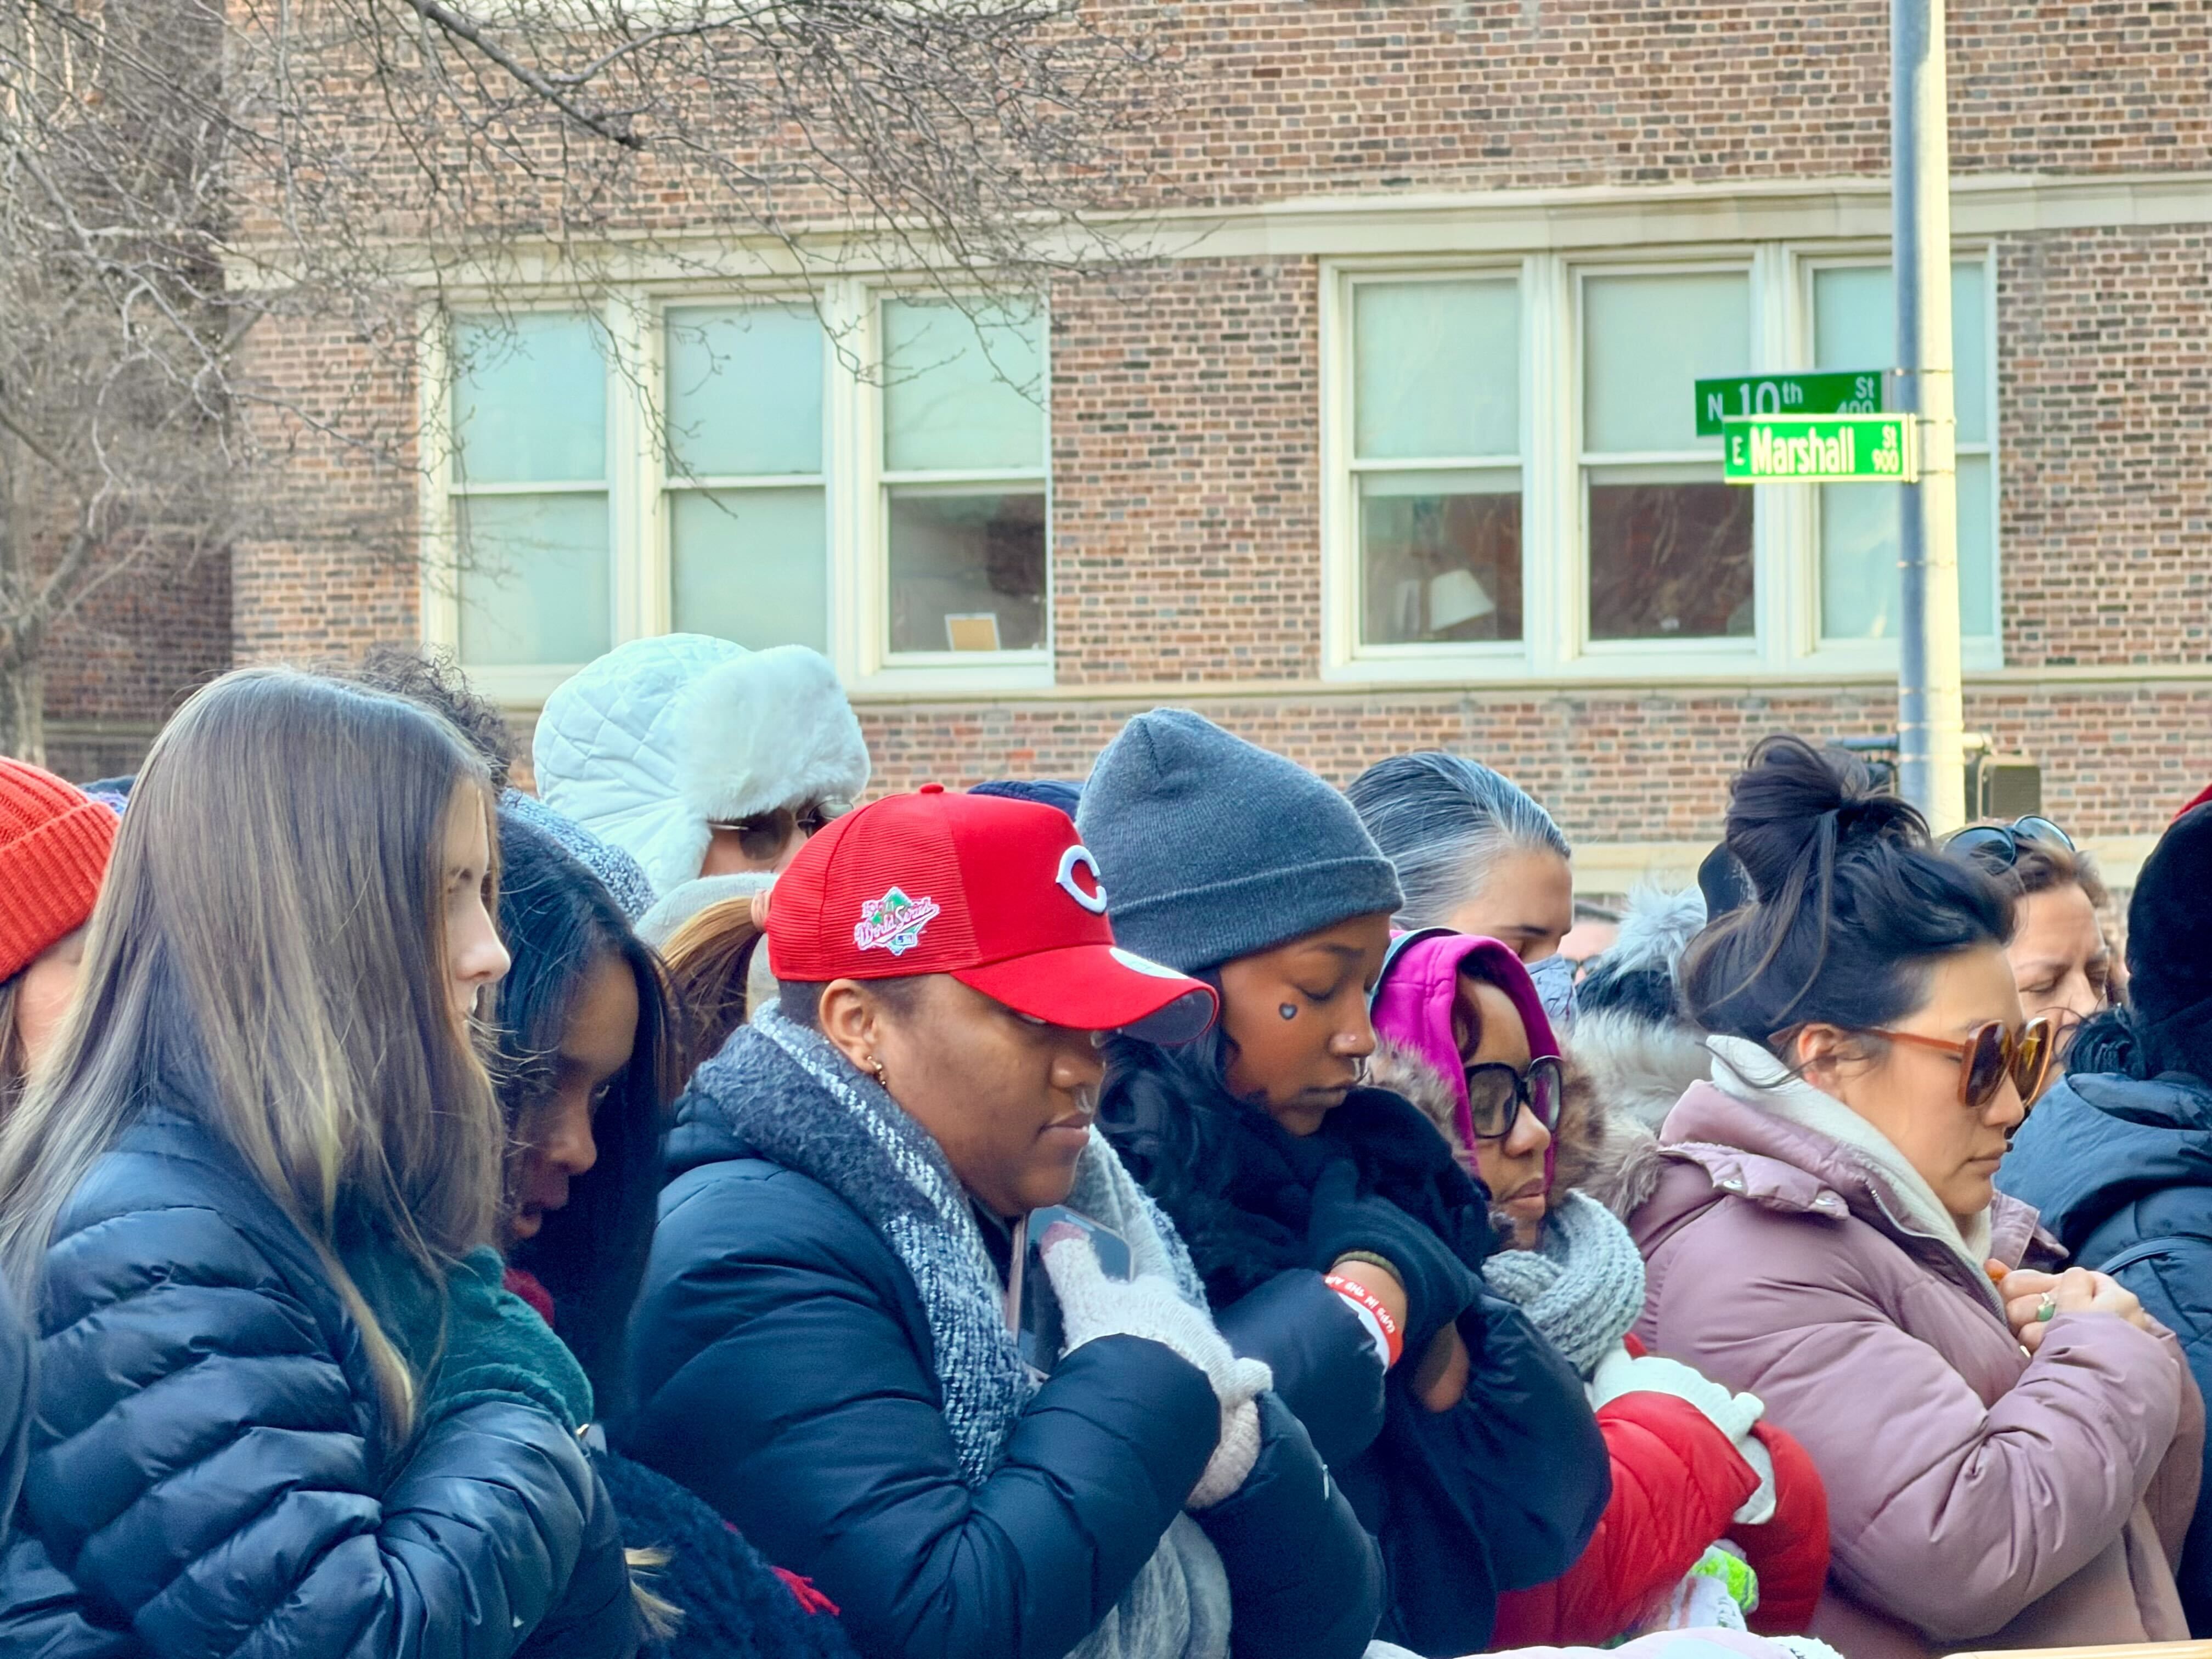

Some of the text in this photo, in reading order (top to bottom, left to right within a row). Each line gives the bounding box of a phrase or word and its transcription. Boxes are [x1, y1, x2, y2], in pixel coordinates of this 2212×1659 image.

[1855, 376, 1874, 399] St
[1707, 381, 1803, 421] N 10th
[1882, 424, 1897, 449] St
[1731, 426, 1855, 474] E Marshall
[1871, 449, 1899, 472] 900
[1056, 845, 1107, 913] C
[855, 914, 896, 947] World
[1345, 1282, 1365, 1297] THE
[1364, 1295, 1380, 1309] IN
